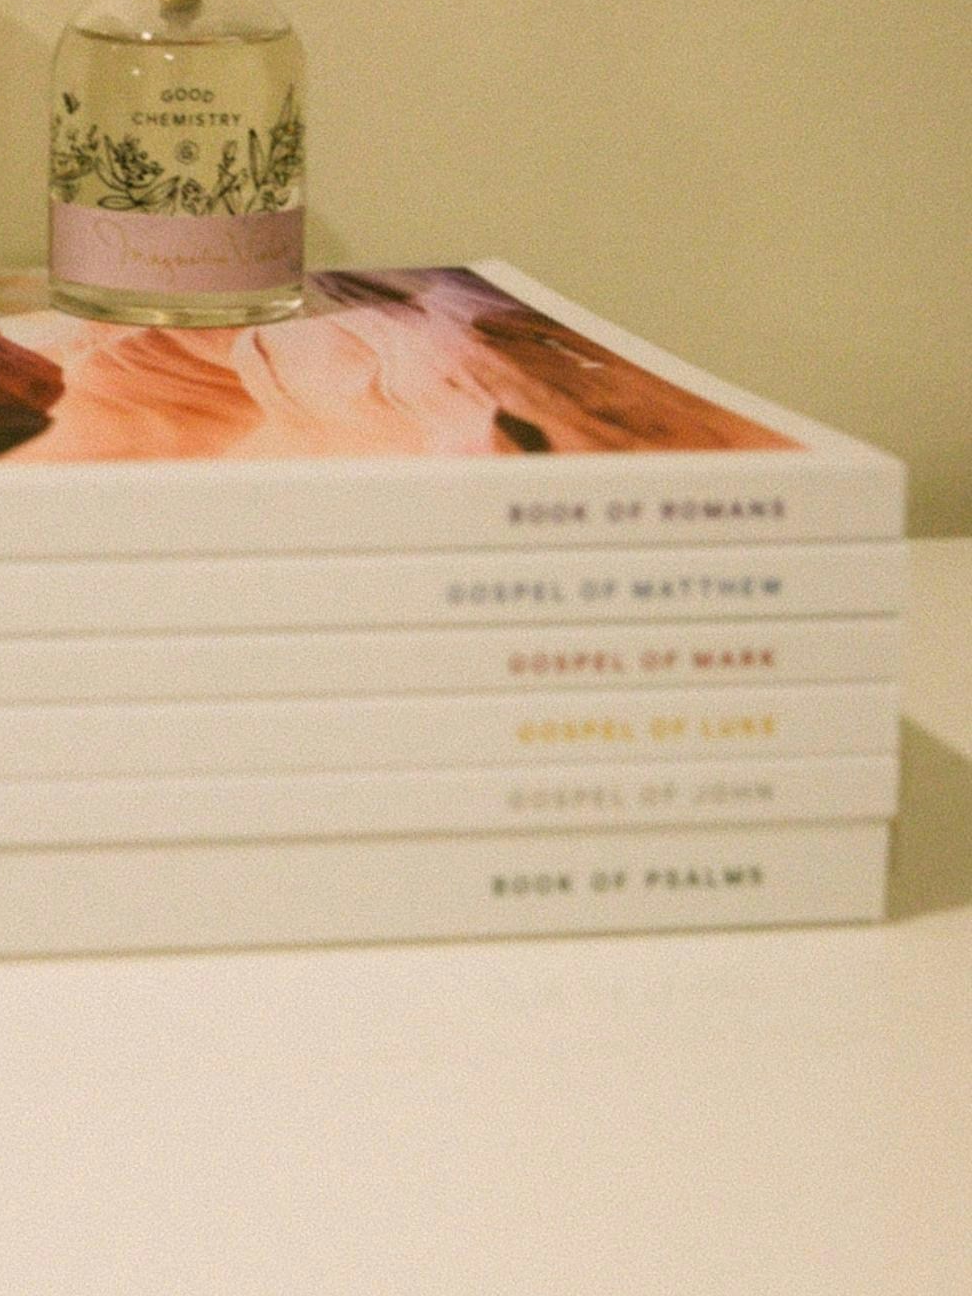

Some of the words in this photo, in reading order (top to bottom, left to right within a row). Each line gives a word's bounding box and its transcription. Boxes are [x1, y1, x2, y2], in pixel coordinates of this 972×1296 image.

[160, 87, 215, 104] GOOD
[131, 111, 242, 127] CHEMISTRY
[508, 502, 587, 526] BOOK
[605, 500, 644, 523] OF
[659, 497, 788, 522] ROMANS
[445, 581, 565, 605] GOSPEL
[581, 578, 619, 601] OF
[632, 574, 783, 599] MATTHEW
[507, 650, 625, 676] GOSPEL
[639, 647, 678, 672] OF
[692, 645, 776, 669] MARK
[515, 718, 634, 744] GOSPEL
[649, 715, 686, 741] OF
[699, 713, 776, 740] LUKE
[507, 784, 623, 810] GOSPEL
[639, 781, 677, 806] OF
[694, 778, 775, 803] JOHN
[490, 872, 573, 898] BOOK
[589, 869, 626, 894] OF
[643, 863, 764, 891] PSALMS
